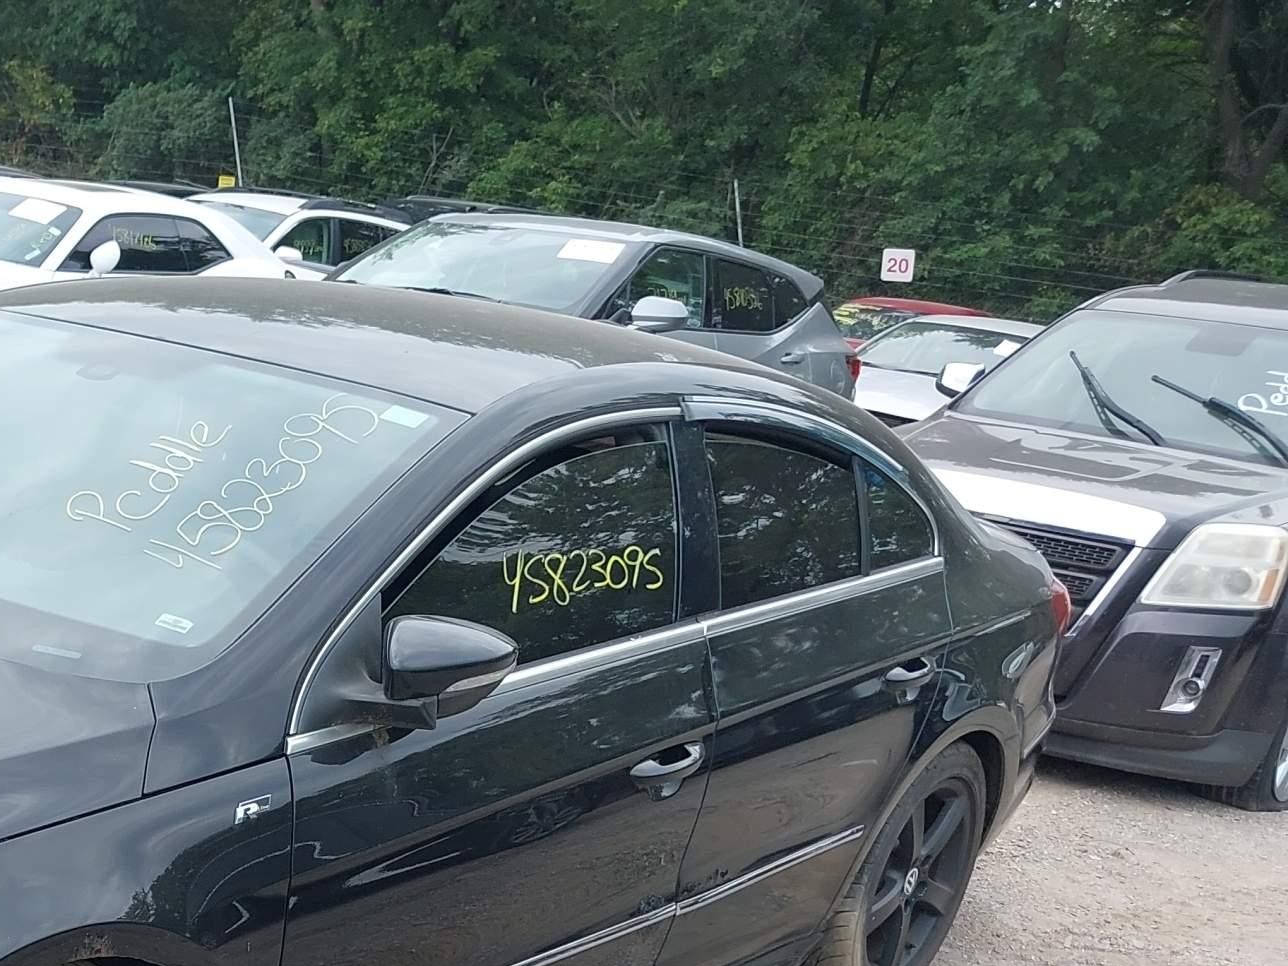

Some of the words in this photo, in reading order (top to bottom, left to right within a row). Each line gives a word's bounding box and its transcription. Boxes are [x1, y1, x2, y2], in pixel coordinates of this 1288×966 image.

[886, 257, 910, 274] 20
[143, 392, 379, 570] 45823095
[503, 545, 664, 614] 45823095
